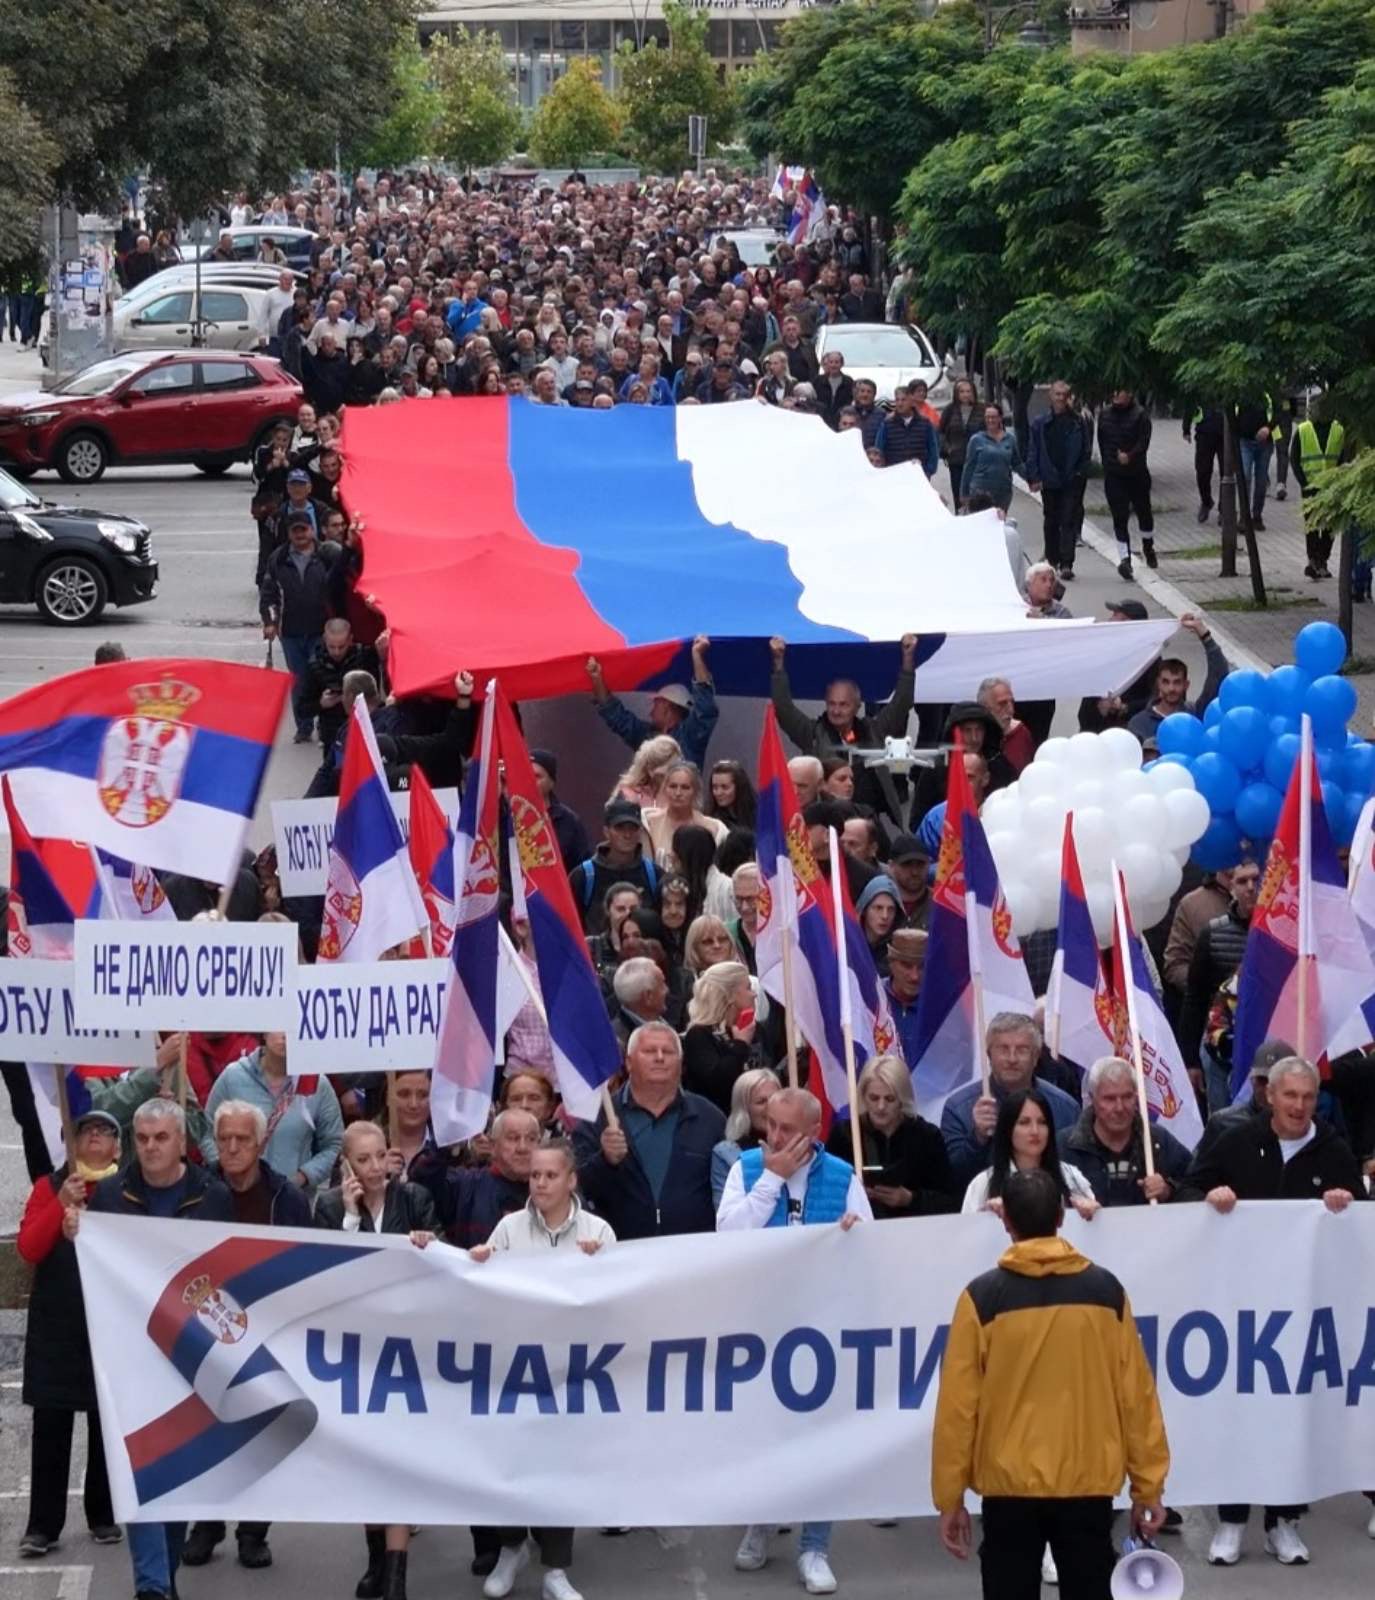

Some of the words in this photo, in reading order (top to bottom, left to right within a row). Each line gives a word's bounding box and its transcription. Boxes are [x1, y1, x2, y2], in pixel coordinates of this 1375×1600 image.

[284, 824, 322, 871] ХОЋУ
[93, 944, 121, 995] НЕ
[126, 944, 190, 1007] ДАМО
[195, 944, 284, 998] СРБИЈУ!
[297, 986, 362, 1041] ХОЋУ
[368, 985, 401, 1048] ДА
[305, 1327, 627, 1416] ЧАЧАК
